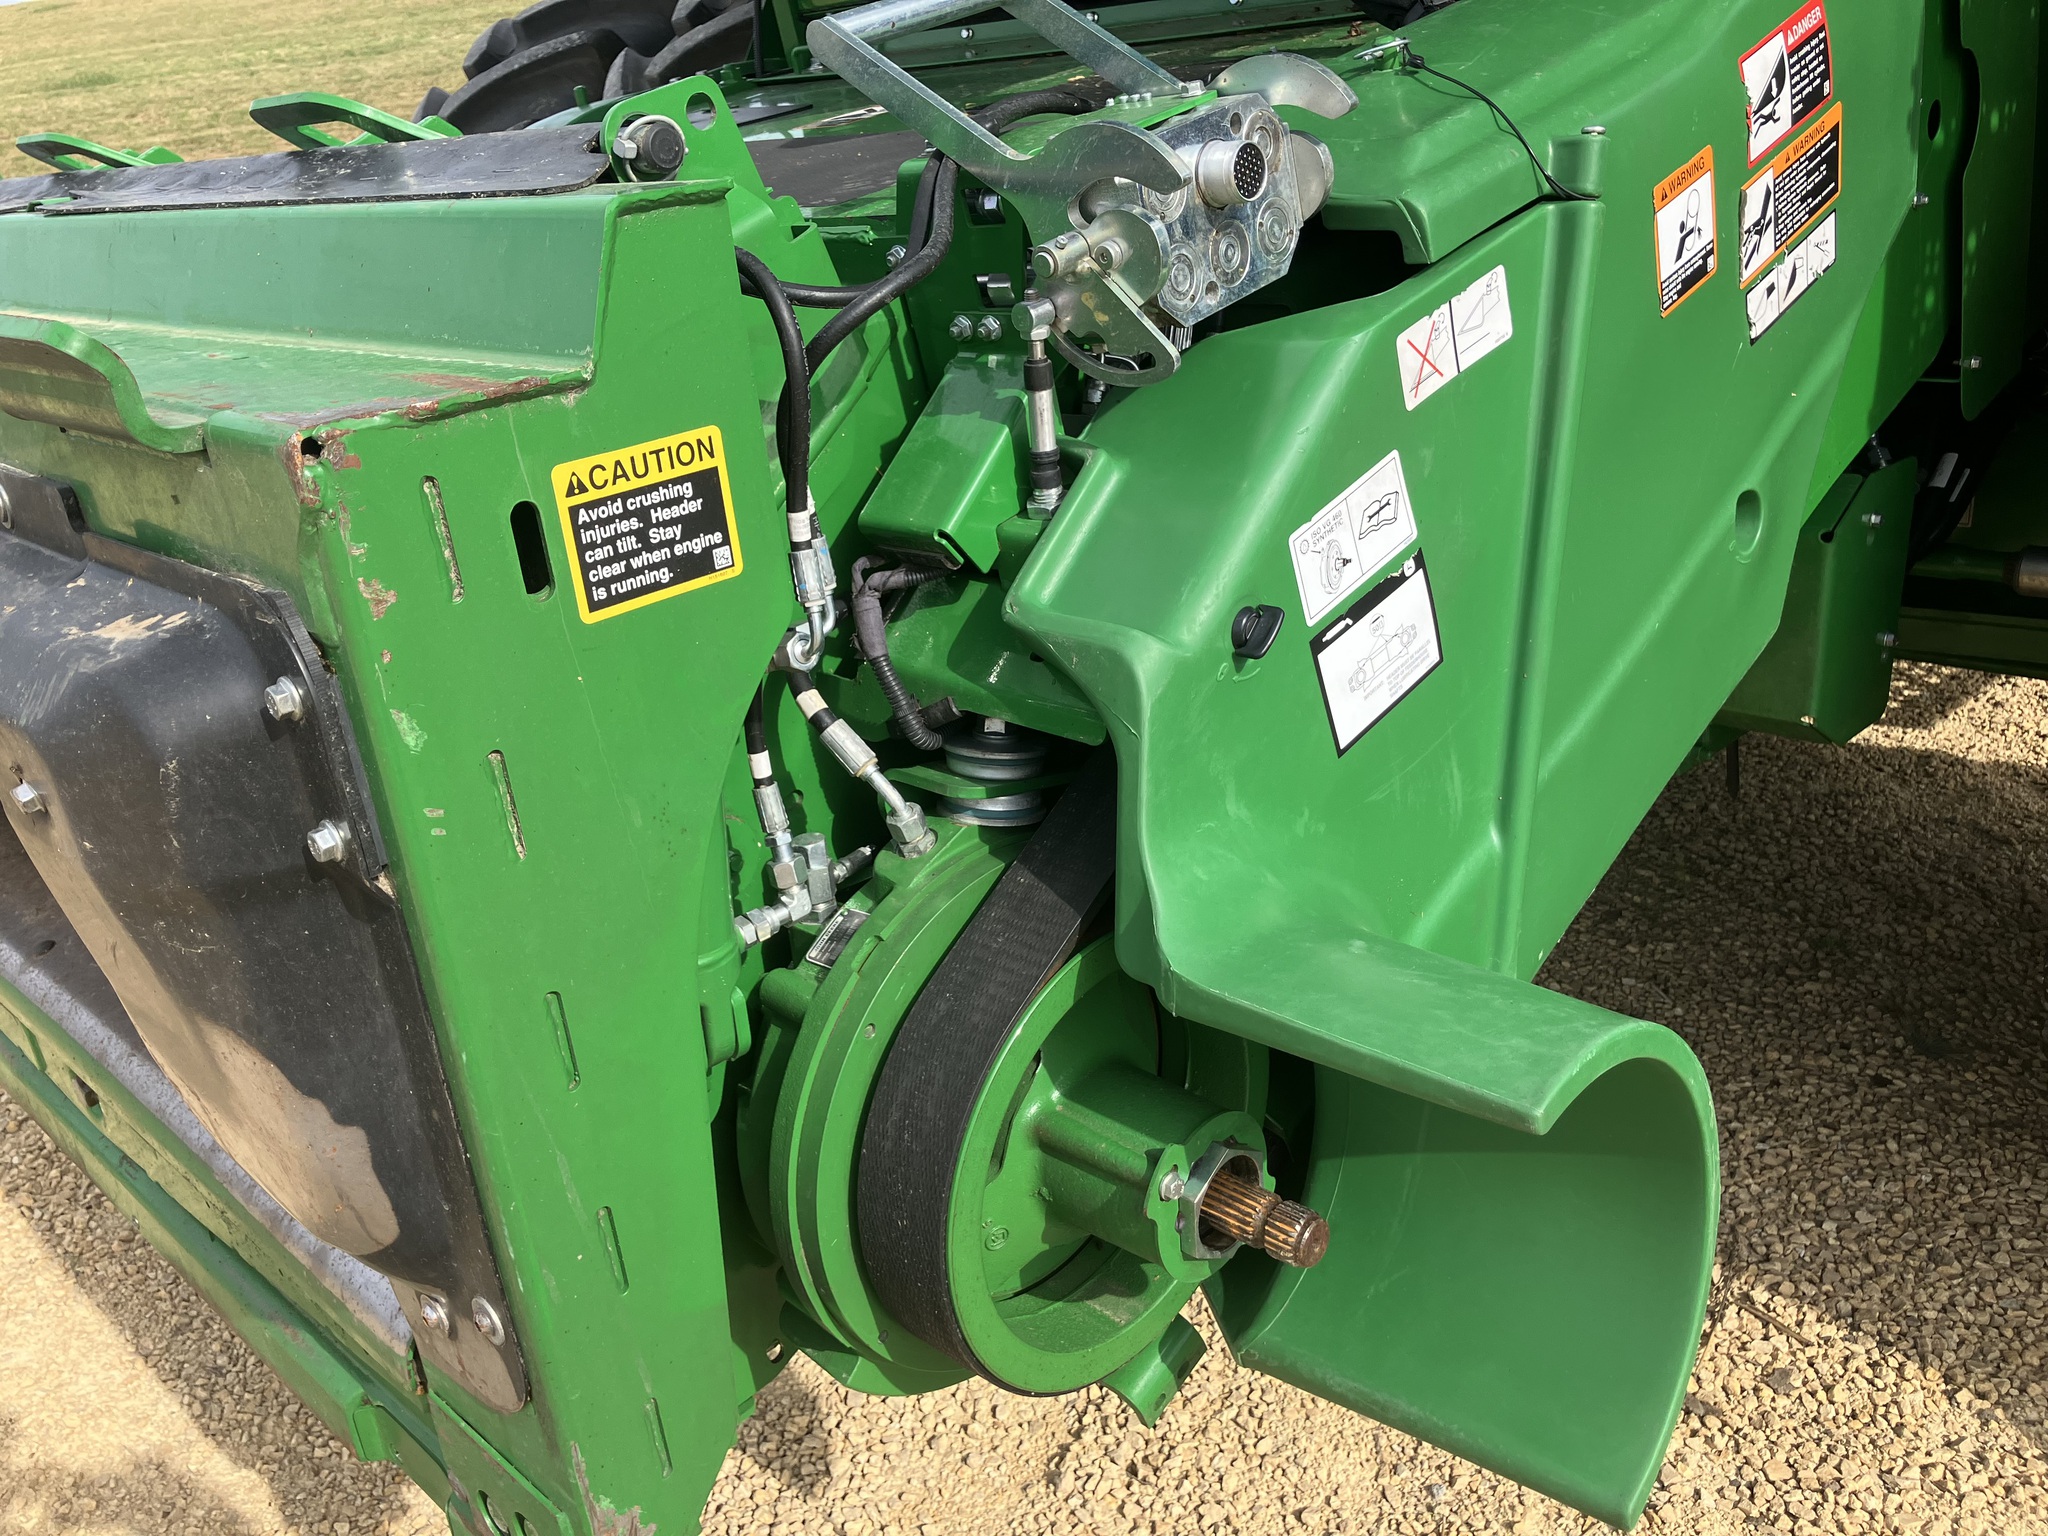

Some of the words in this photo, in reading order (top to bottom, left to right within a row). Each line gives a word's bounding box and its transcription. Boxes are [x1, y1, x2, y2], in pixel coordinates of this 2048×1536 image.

[1792, 6, 1822, 40] DANGER
[1792, 120, 1825, 156] WARNING
[1669, 156, 1705, 194] WARNING
[588, 435, 716, 490] CAUTION
[578, 498, 623, 525] Avoid
[626, 481, 693, 511] crushing
[580, 517, 644, 545] injuries.
[650, 498, 703, 524] Header
[584, 546, 614, 563] can
[616, 534, 642, 550] tilt.
[648, 524, 682, 544] Stay
[1311, 527, 1321, 540] ISO
[1322, 519, 1331, 529] VG
[1312, 518, 1344, 548] SYNTHETIC
[588, 559, 627, 582] clear
[630, 547, 671, 570] when
[674, 531, 723, 556] engine
[592, 586, 607, 602] is
[610, 566, 674, 596] running.
[815, 937, 826, 952] JOHN
